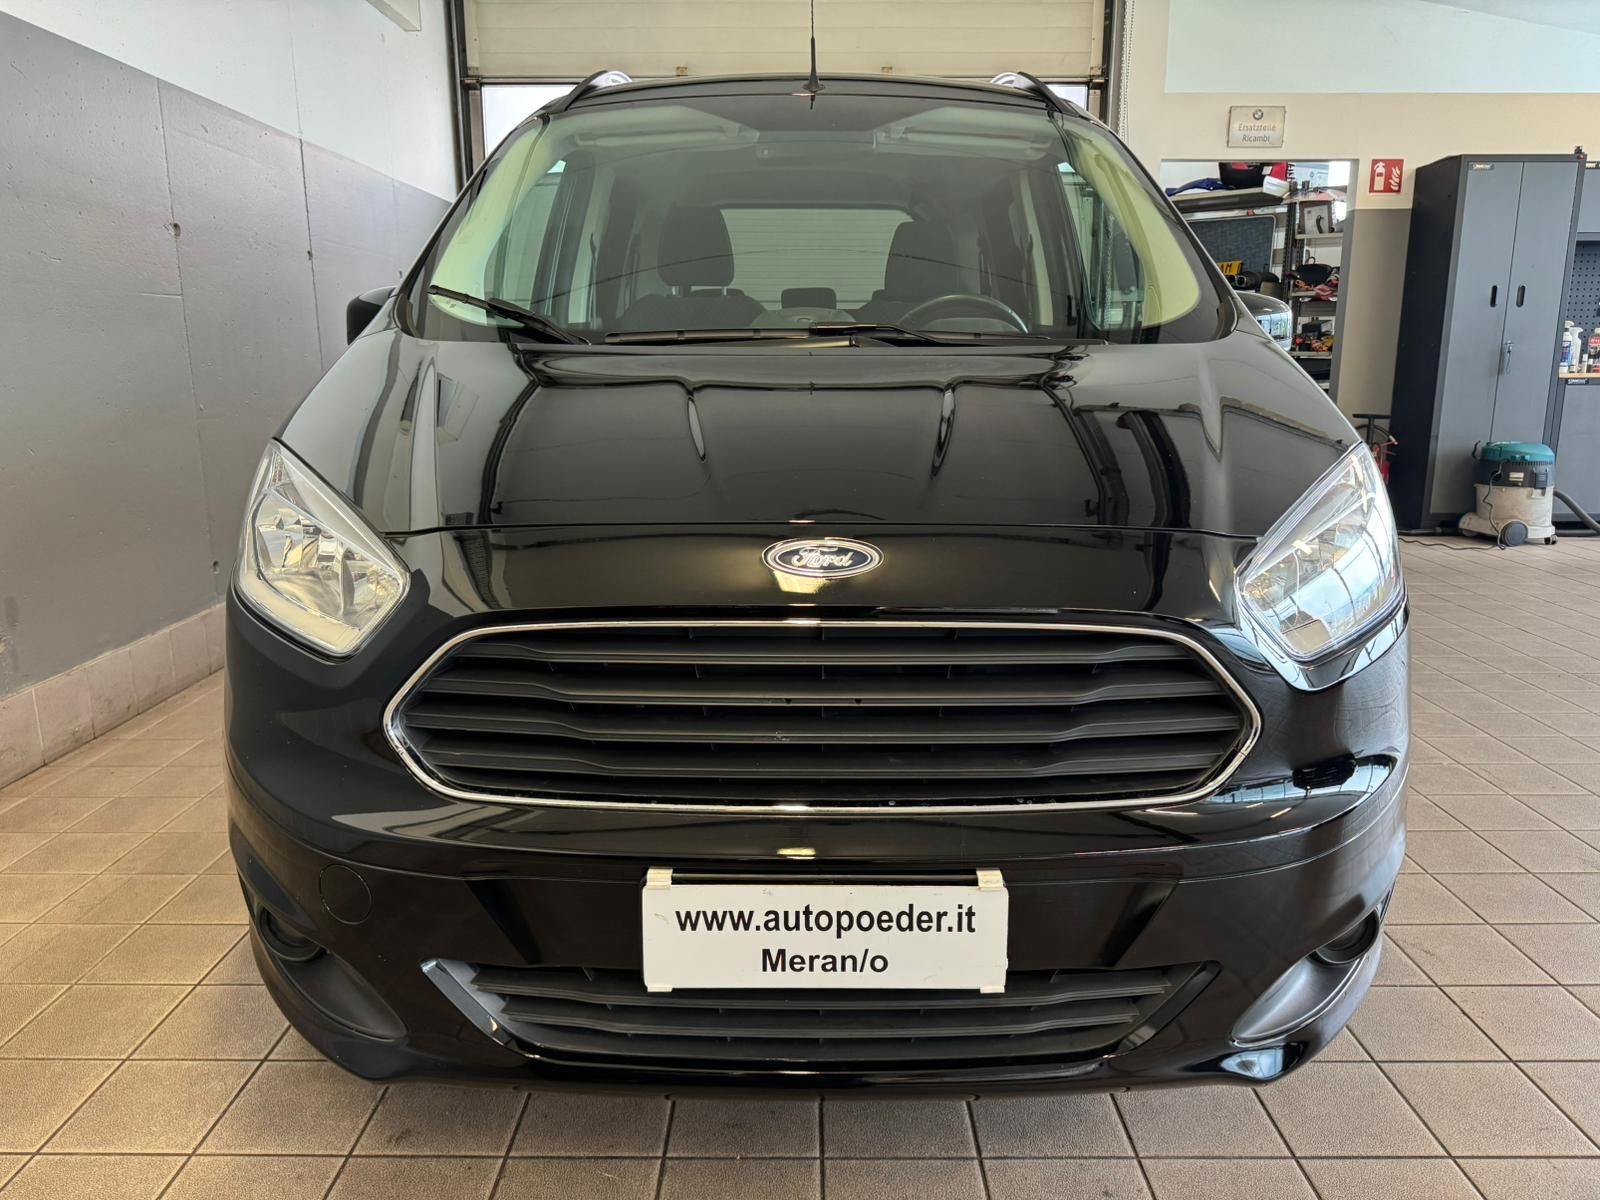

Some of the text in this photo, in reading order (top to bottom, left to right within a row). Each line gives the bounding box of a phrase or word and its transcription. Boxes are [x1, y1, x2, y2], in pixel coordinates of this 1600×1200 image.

[1238, 122, 1277, 132] Ersatzteile
[1241, 134, 1271, 143] Ricambi
[791, 546, 854, 568] Ford
[675, 903, 976, 939] www.autopoeder.it
[761, 948, 889, 973] Meran/o
